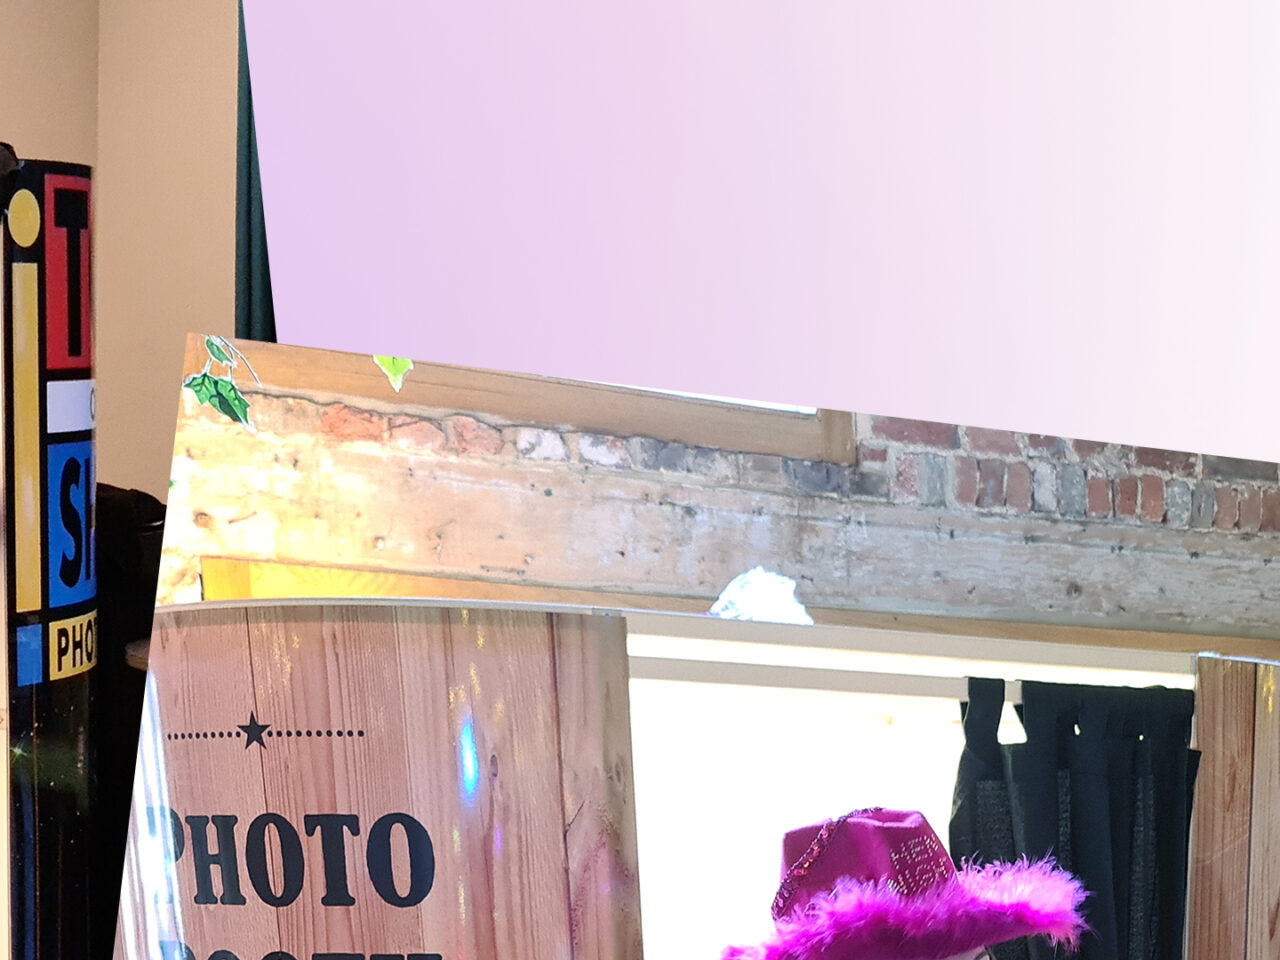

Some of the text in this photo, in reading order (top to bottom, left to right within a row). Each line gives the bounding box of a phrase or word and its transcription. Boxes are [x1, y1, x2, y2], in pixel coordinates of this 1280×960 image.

[57, 617, 97, 672] PHO
[145, 806, 435, 908] PHOTO
[887, 857, 948, 896] NIGH
